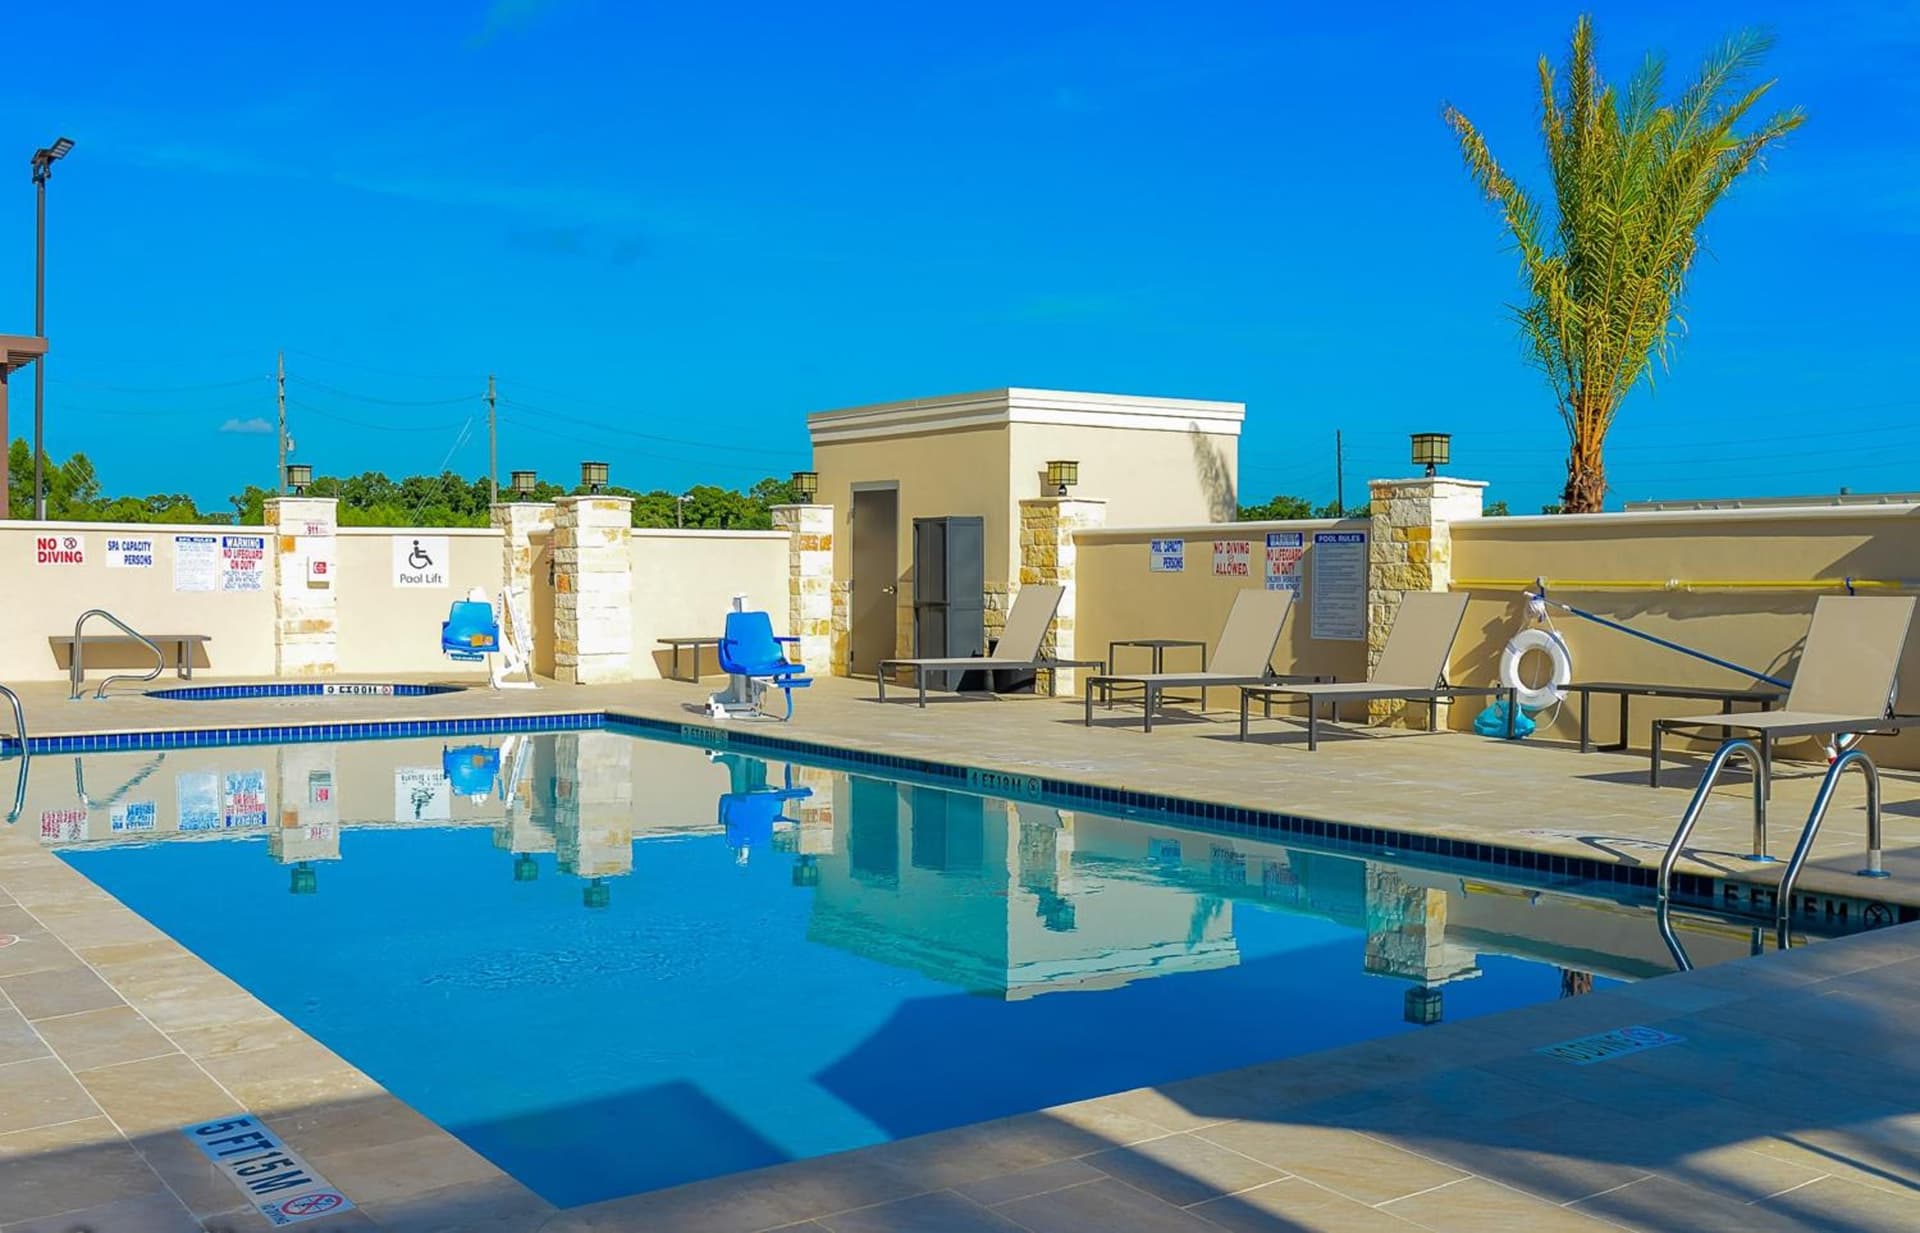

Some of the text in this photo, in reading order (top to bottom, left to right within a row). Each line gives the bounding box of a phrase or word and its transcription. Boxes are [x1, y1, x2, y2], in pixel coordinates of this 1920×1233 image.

[37, 538, 57, 550] NO
[1318, 535, 1361, 543] POOL RULES
[108, 541, 152, 552] SPA CAPACITY
[1214, 542, 1250, 554] NO DIVING
[37, 551, 84, 563] DIVING
[124, 555, 152, 566] PERSONS
[1215, 563, 1248, 575] ALLOWED
[400, 573, 443, 584] Pool Lift
[195, 1119, 251, 1136] 5
